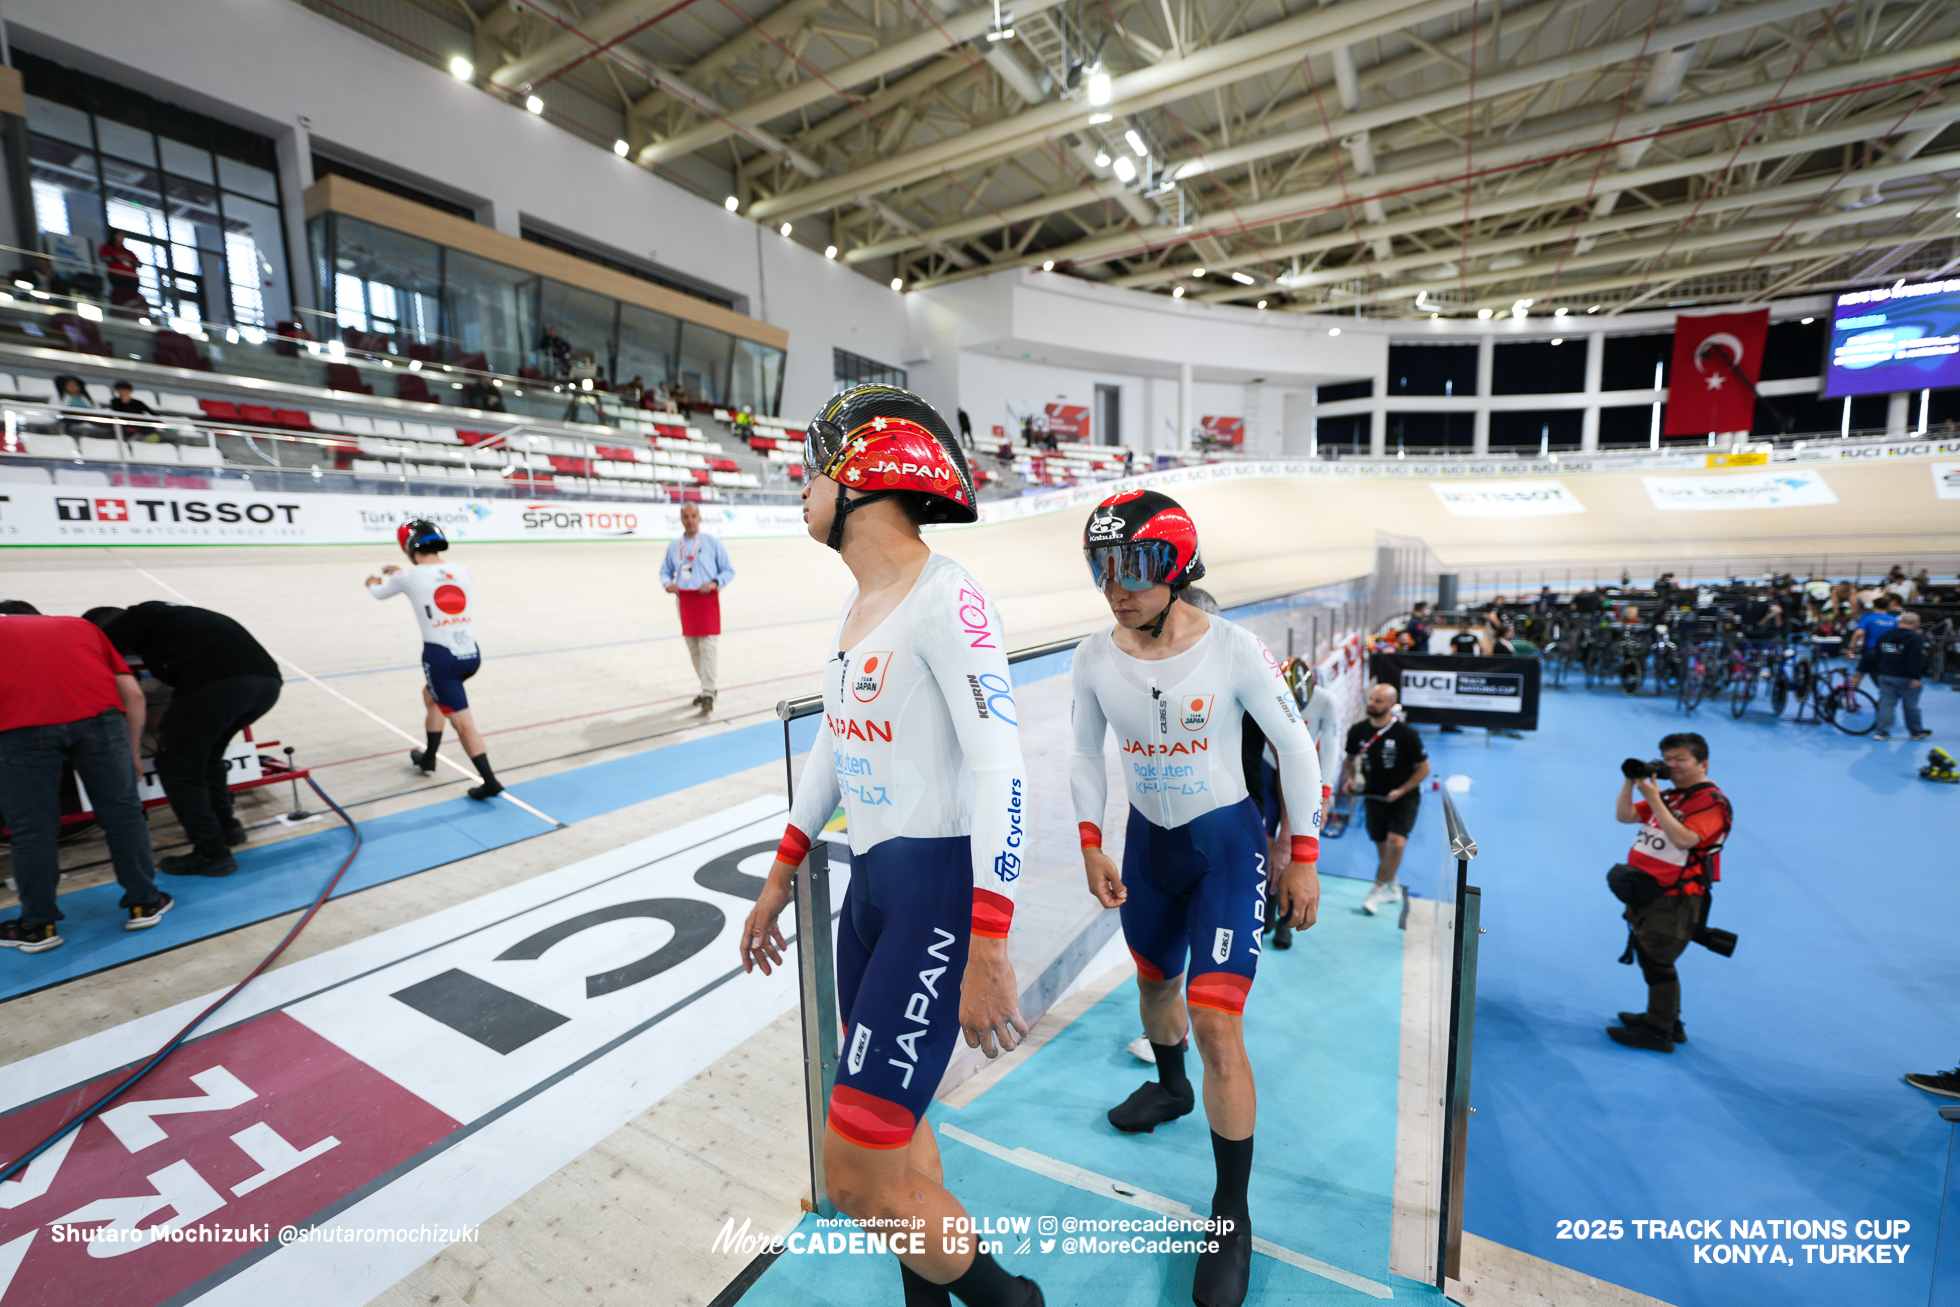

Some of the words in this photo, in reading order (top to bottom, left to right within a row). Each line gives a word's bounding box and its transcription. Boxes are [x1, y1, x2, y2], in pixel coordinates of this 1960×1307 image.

[868, 460, 950, 480] JAPAN
[136, 500, 300, 524] TISSOT
[855, 682, 877, 691] JAPAN
[966, 674, 990, 719] KEIRIN
[1160, 700, 1168, 734] Q36.5
[1276, 696, 1297, 724] KEIRIN
[1123, 738, 1208, 756] JAPAN
[1134, 762, 1194, 778] Rakuten
[1006, 778, 1023, 848] Cyclers
[1249, 852, 1267, 970] JAPAN
[888, 927, 956, 1090] JAPAN
